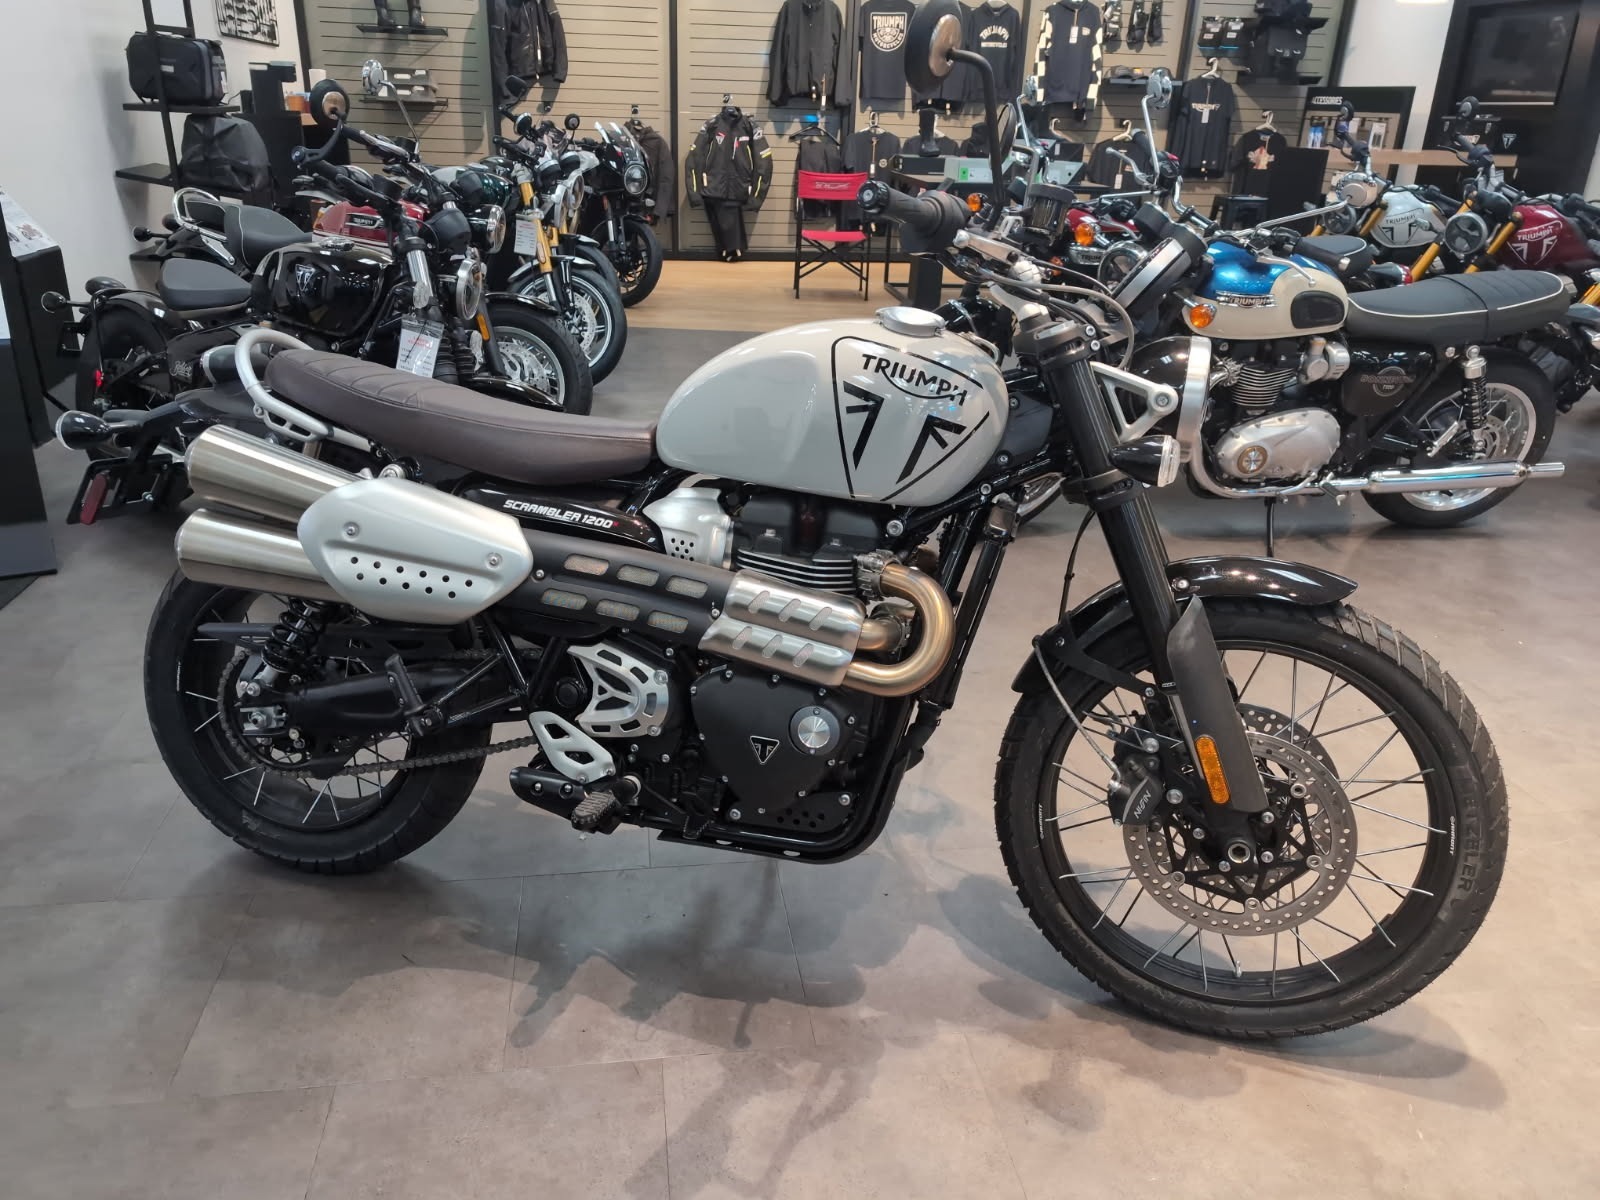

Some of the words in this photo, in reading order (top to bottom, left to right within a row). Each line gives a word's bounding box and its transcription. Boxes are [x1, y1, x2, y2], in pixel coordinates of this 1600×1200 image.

[872, 15, 904, 30] TRIUMPH
[862, 354, 968, 406] TRIUMPH
[503, 499, 582, 523] SCRAMBLER
